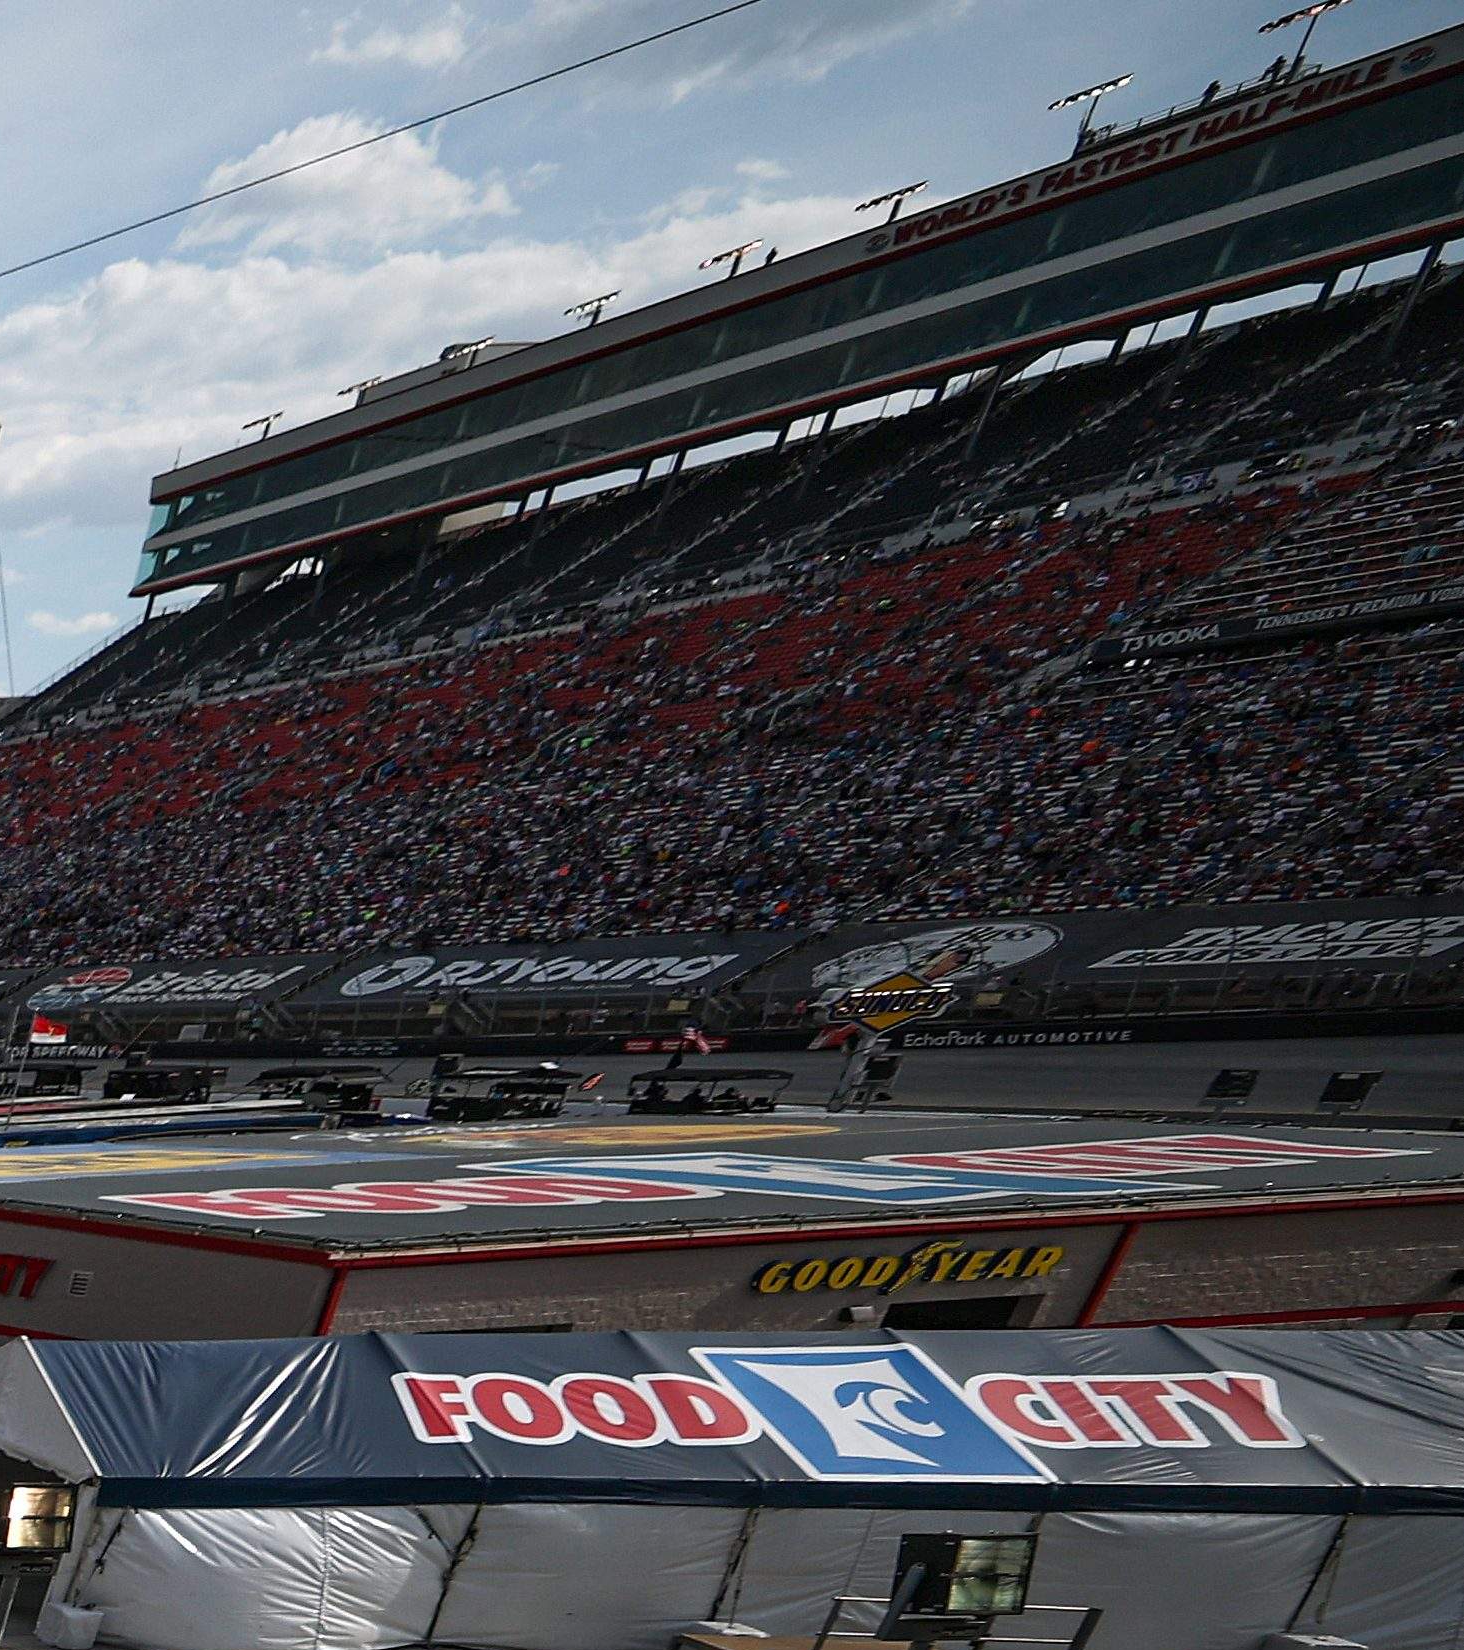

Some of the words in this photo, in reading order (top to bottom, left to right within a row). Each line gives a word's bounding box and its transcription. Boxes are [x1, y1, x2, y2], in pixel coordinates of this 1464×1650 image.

[891, 180, 1028, 246] WORLD'S
[1037, 126, 1192, 196] FASTEST
[1191, 57, 1394, 147] HALF-MILE
[1167, 915, 1464, 949] TRACKER
[829, 984, 955, 1020] SUNOCO
[31, 1044, 107, 1058] SPEEDWAY
[903, 1030, 986, 1047] EchoPark
[992, 1029, 1133, 1046] AUTOMOTIVE
[751, 1240, 1065, 1296] GOODYEAR
[391, 1372, 765, 1447] FOOD
[964, 1371, 1308, 1449] CITY
